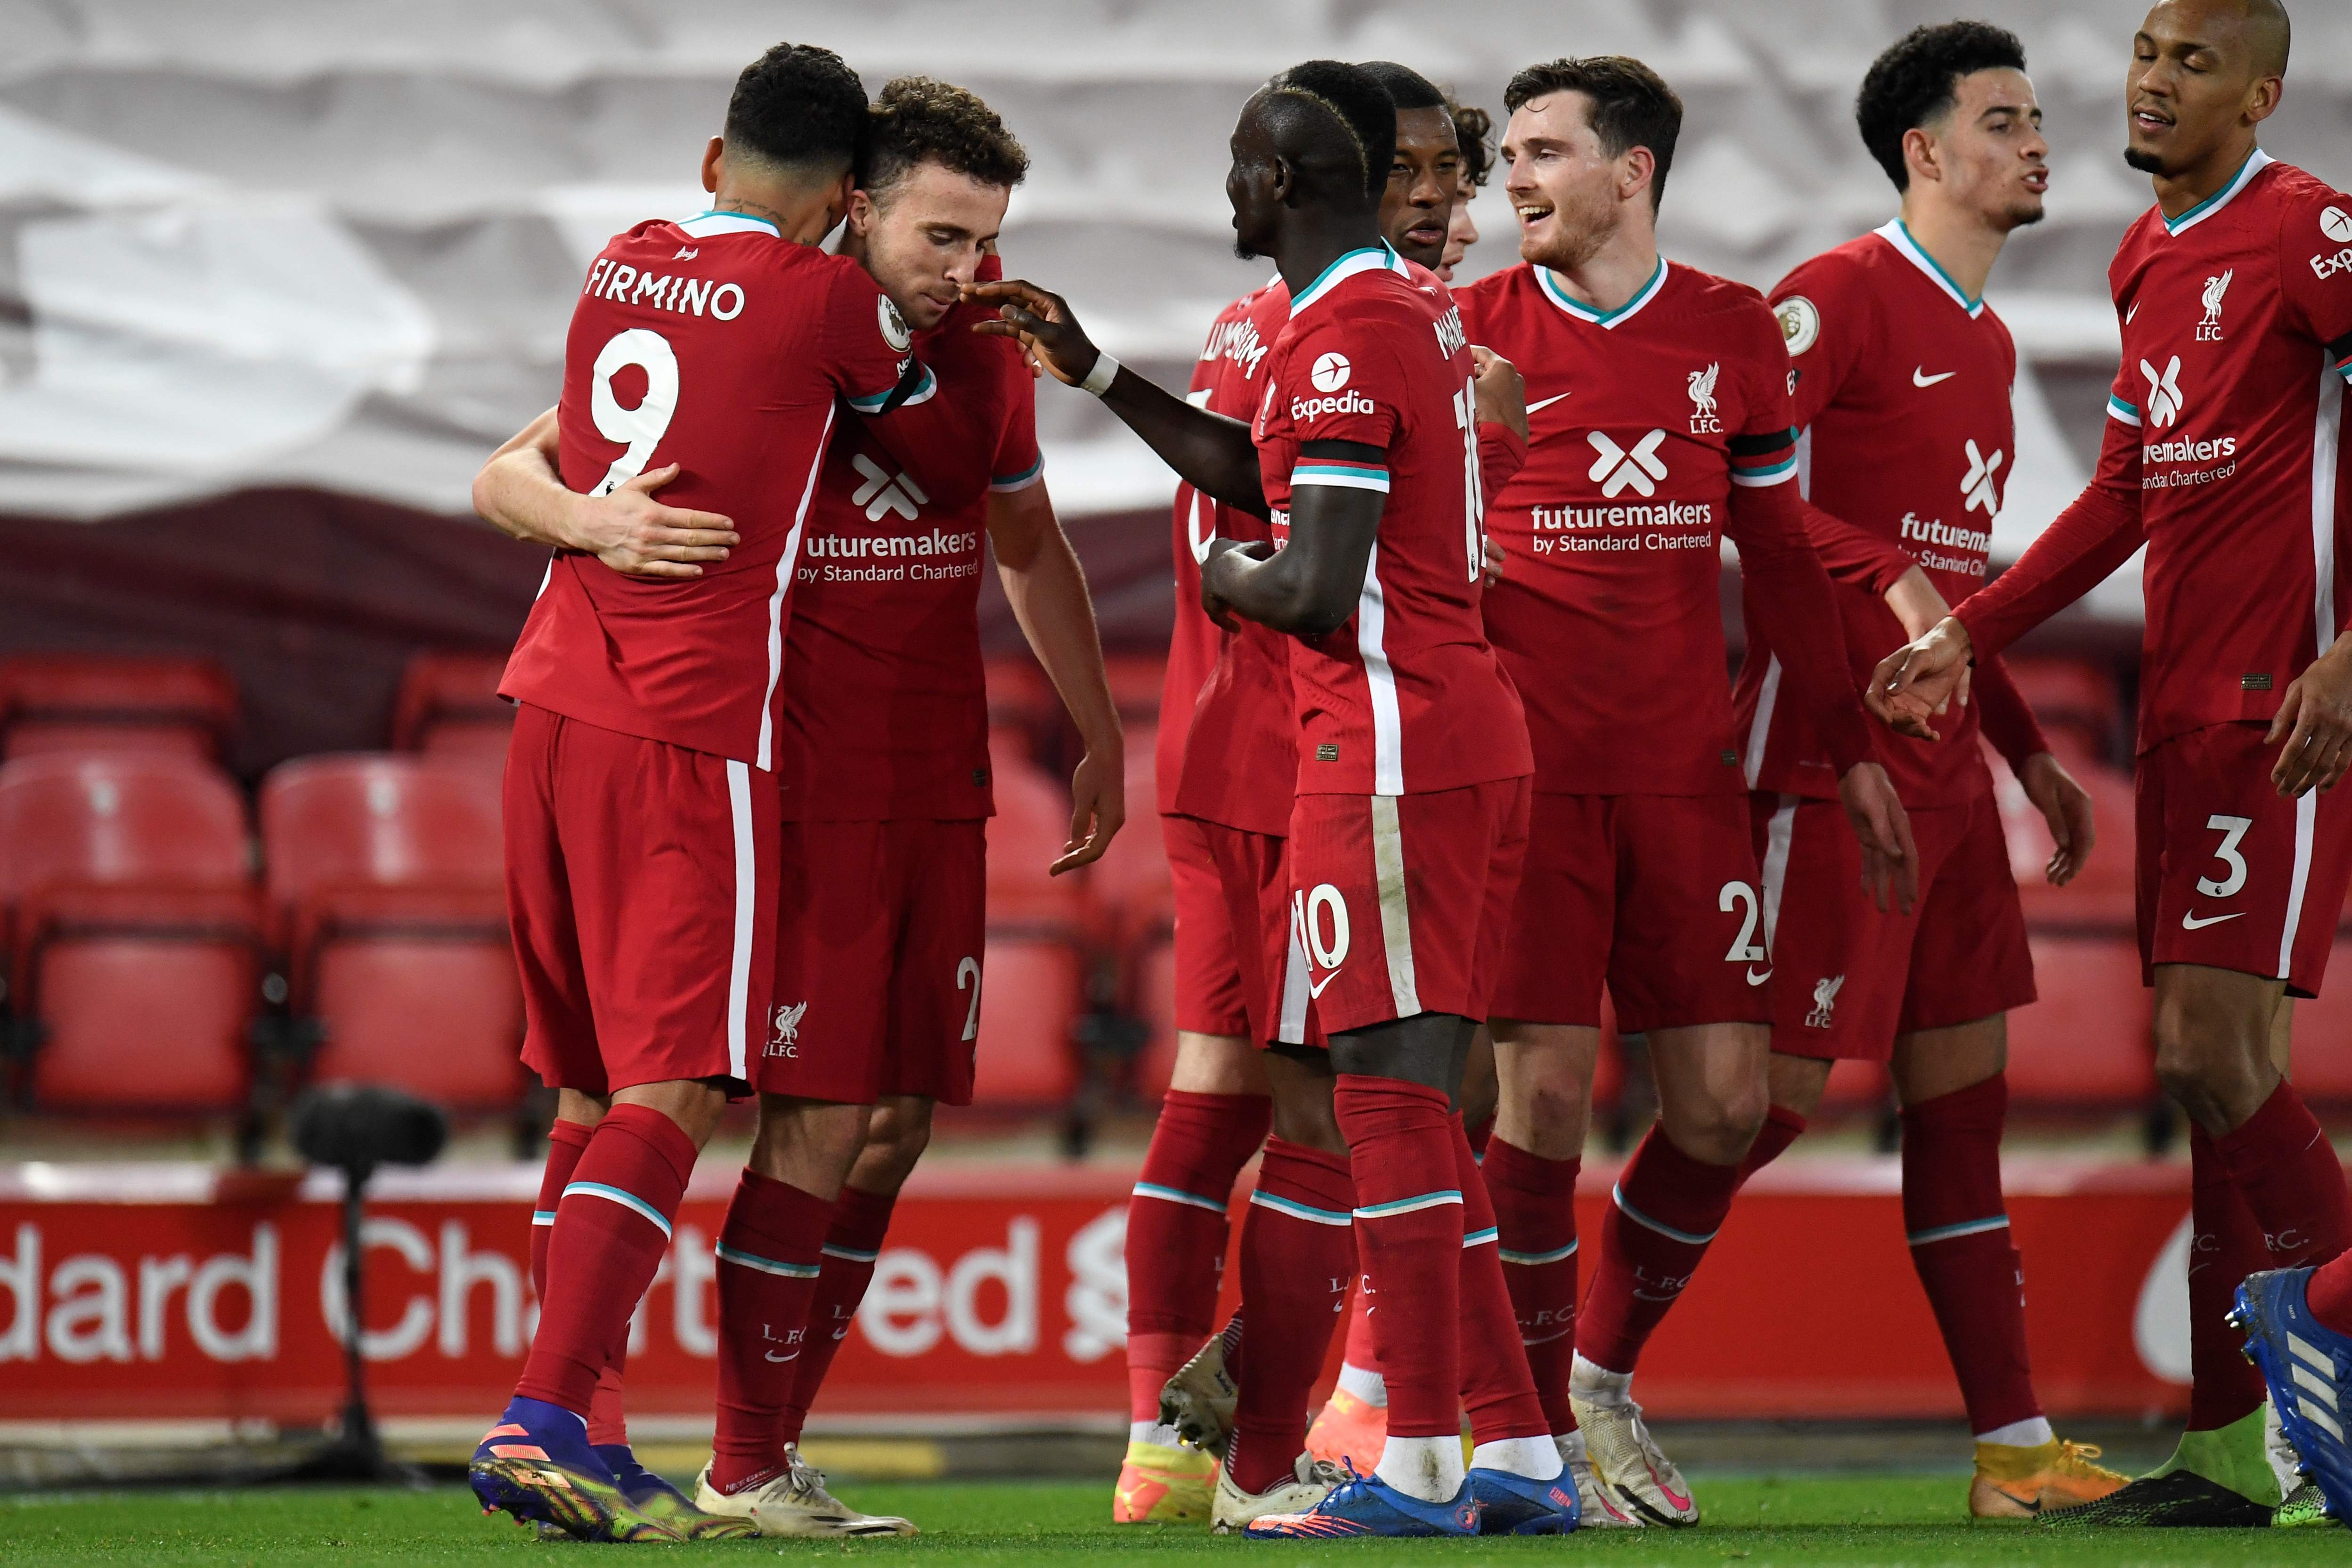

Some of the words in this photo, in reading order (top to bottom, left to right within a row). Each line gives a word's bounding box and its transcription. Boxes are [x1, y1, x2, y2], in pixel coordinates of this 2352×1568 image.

[585, 259, 745, 321] FIRMINO
[2196, 326, 2223, 341] L.F.C.
[588, 328, 680, 497] 9
[1291, 390, 1374, 423] Expedia
[1690, 419, 1724, 433] L.F.C.
[2170, 460, 2236, 487] Chartered
[1531, 500, 1711, 529] futuremakers
[807, 528, 976, 557] uturemakers
[1533, 535, 1554, 555] by
[1559, 533, 1639, 552] Standard
[1645, 531, 1711, 550] Chartered
[798, 567, 819, 584] by
[824, 565, 903, 581] Standard
[910, 558, 978, 580] Chartered
[2196, 814, 2253, 897] 3
[1295, 884, 1350, 972] 10
[1719, 880, 1764, 961] 2
[957, 956, 981, 1041] 2
[769, 1044, 799, 1058] L.F.C.
